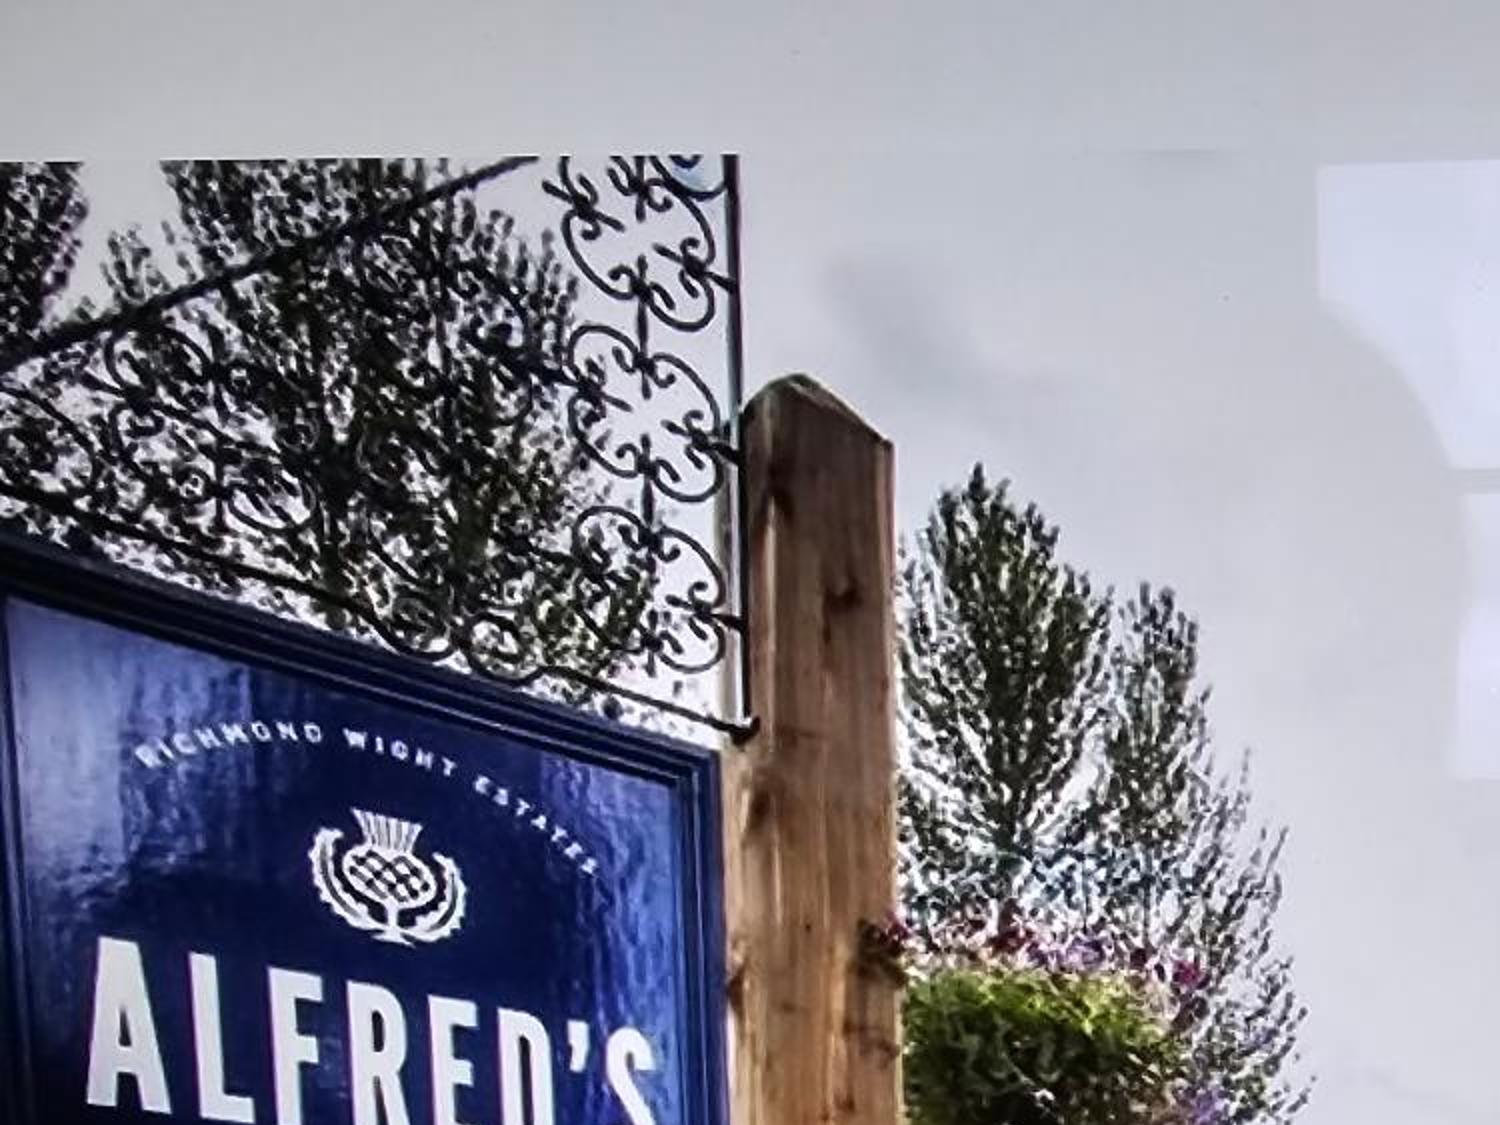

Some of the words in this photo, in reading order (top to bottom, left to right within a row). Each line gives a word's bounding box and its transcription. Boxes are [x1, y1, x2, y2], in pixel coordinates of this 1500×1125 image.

[134, 721, 323, 769] RICHMOND
[343, 727, 457, 777] WIGHT
[473, 775, 599, 876] ESTATES
